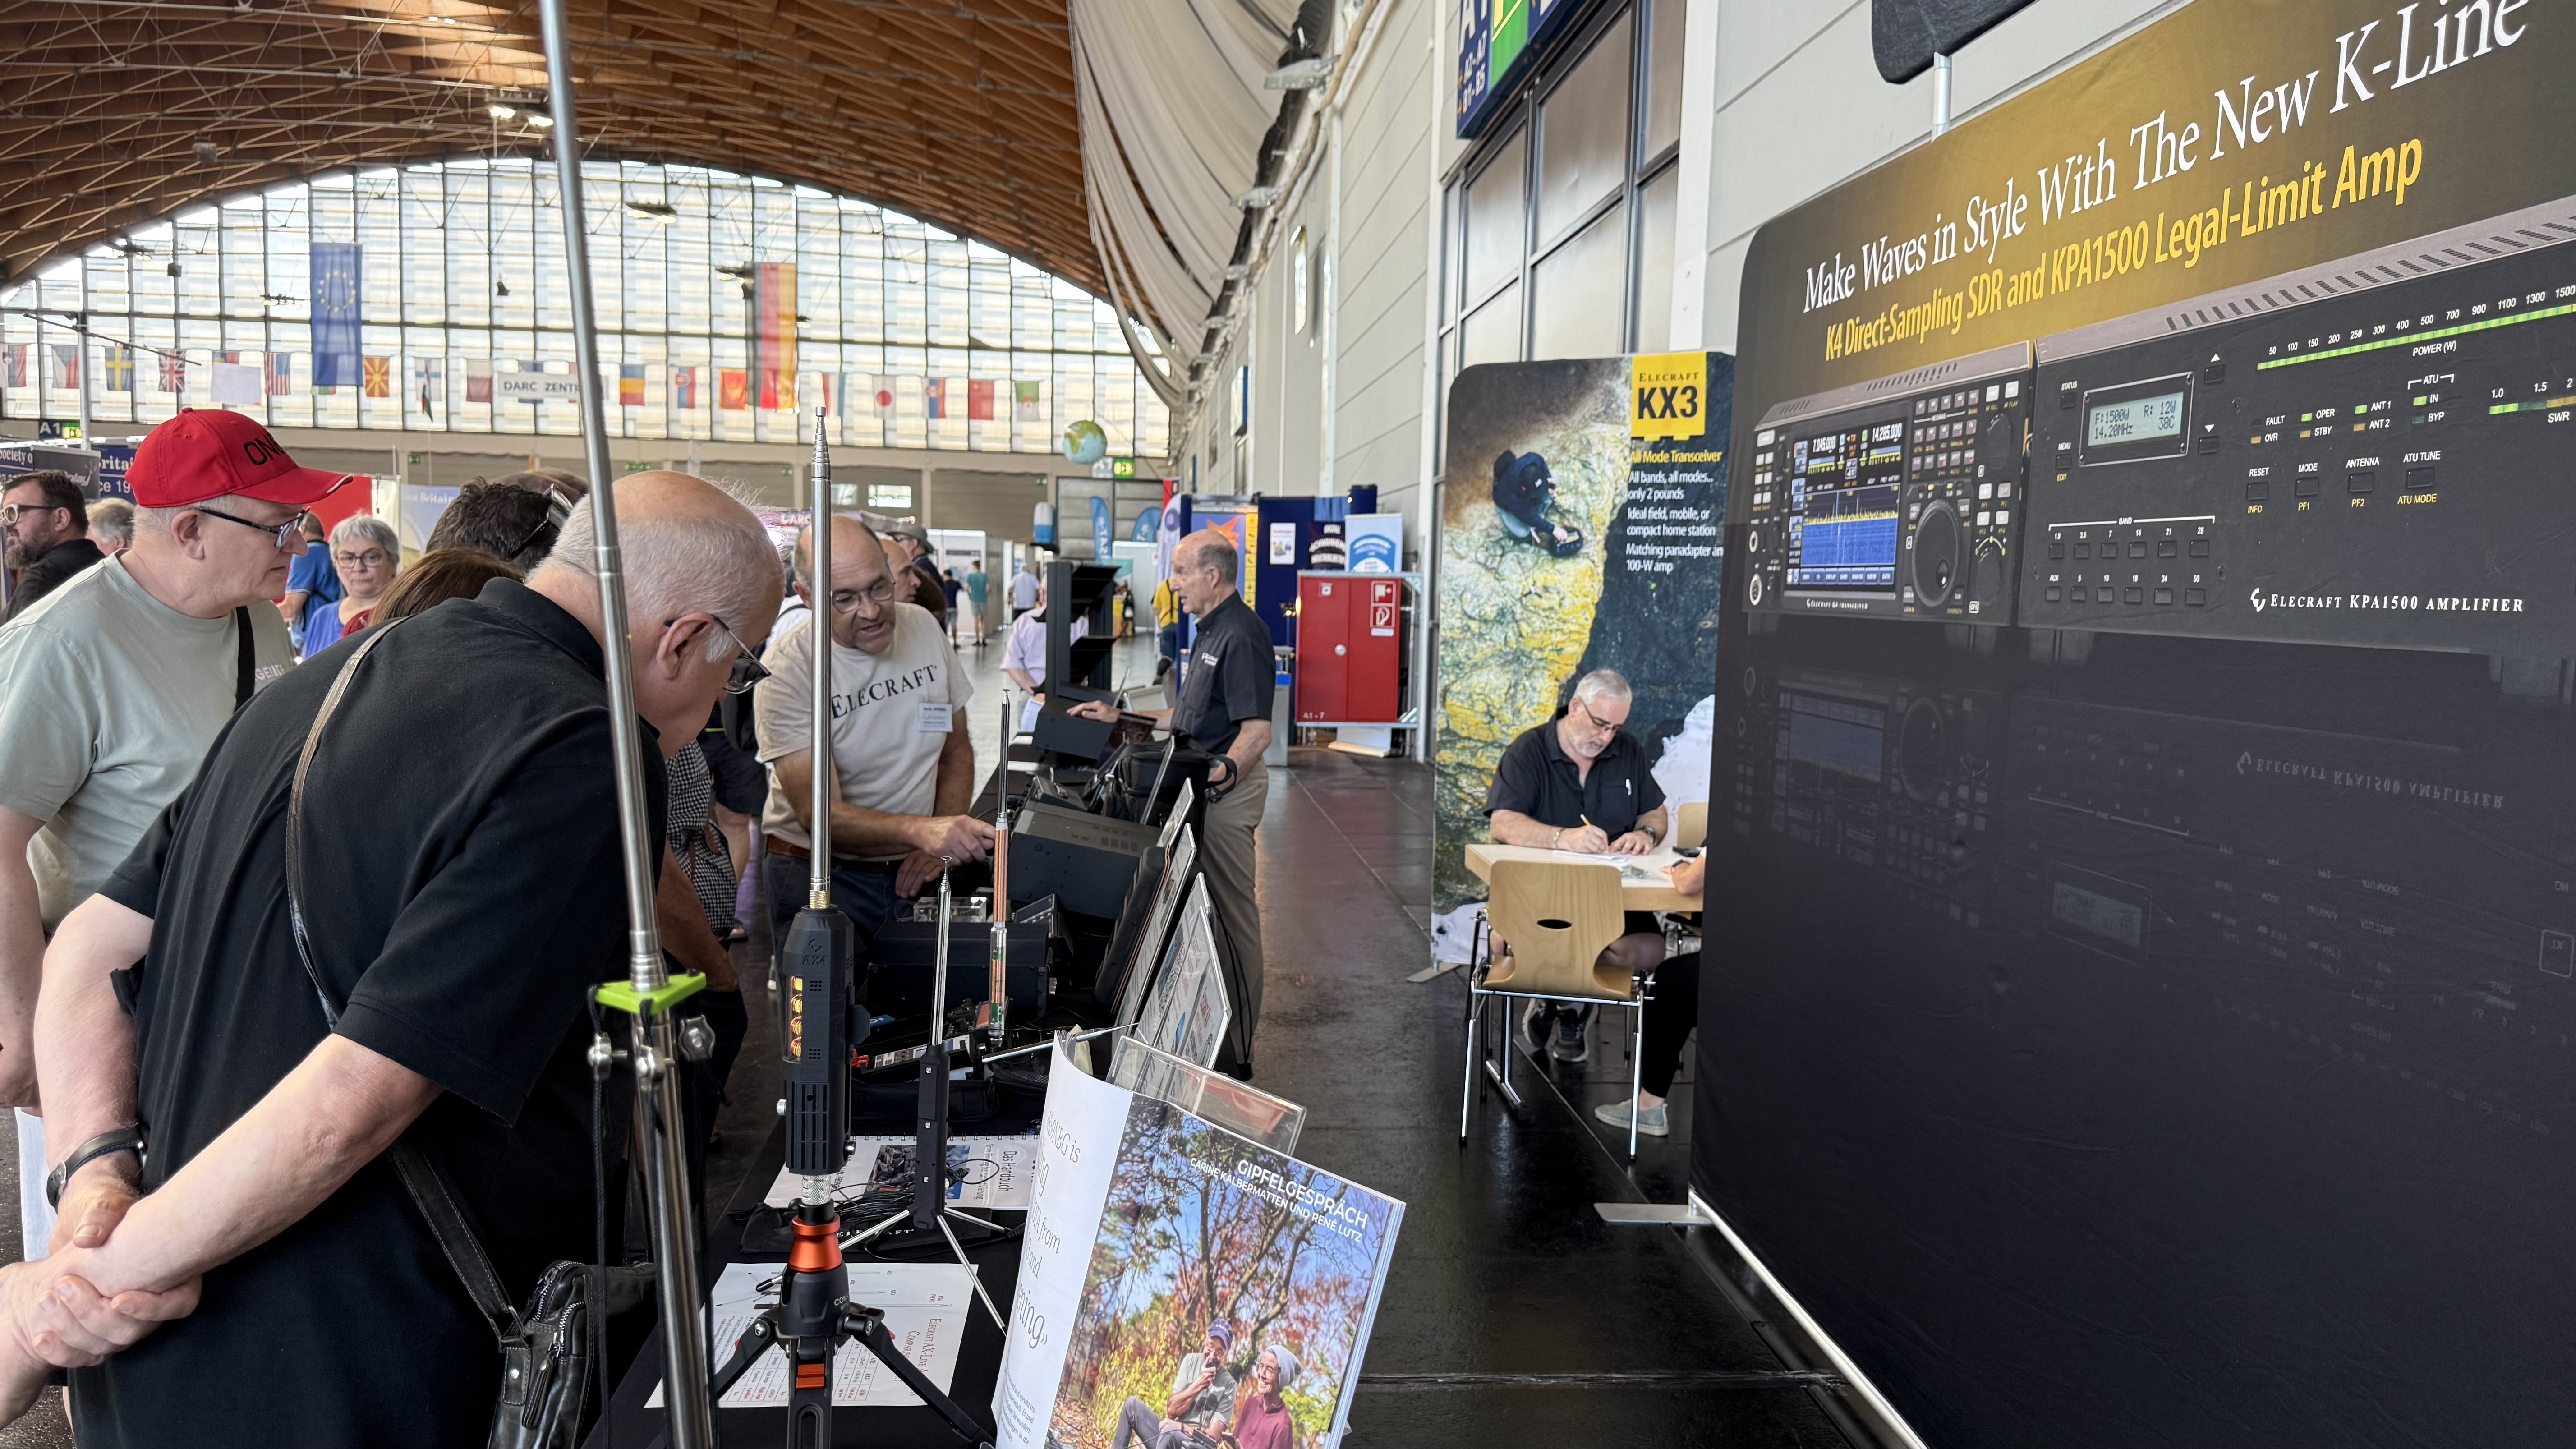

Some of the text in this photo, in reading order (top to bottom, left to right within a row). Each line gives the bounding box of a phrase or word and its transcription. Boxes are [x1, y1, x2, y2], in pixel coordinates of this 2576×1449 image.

[1803, 0, 2526, 313] Make Waves in Style With The New K-Line
[1826, 138, 2422, 361] K4 Direct-Sampling SDR and KPA1500 Legal-Limit Amp
[2269, 285, 2576, 355] 50 100 150 200 250 300 400 500 700 900 1100 1300 1500
[2413, 340, 2456, 356] POWER (W)
[504, 381, 538, 391] DARC
[2061, 381, 2078, 391] STATUS
[2423, 374, 2439, 385] ATU
[2492, 378, 2573, 399] 1.0 1.5 2
[1638, 386, 1697, 419] KX3
[2430, 394, 2438, 403] IN
[2371, 400, 2392, 412] ANT 1
[2266, 415, 2286, 426] FAULT
[2316, 408, 2335, 419] OPER
[2428, 412, 2445, 422] BYP
[2548, 411, 2570, 423] SWR
[2314, 426, 2332, 437] STBY
[2369, 419, 2390, 430] ANT 2
[2264, 433, 2278, 442] OVR
[244, 433, 286, 465] ON
[1631, 449, 1723, 463] All Mode Transceiver
[99, 455, 135, 470] ritai
[2346, 456, 2380, 469] ANTENNA
[2403, 451, 2441, 463] ATU TUNE
[2249, 467, 2269, 477] RESET
[2298, 462, 2318, 473] MODE
[1629, 470, 1640, 483] All
[1641, 470, 1667, 484] bands,
[1668, 470, 1678, 483] all
[1628, 487, 1685, 502] only 2 pounds
[2397, 493, 2438, 505] ATU MODE
[2248, 505, 2263, 514] INFO
[2298, 502, 2310, 511] PF1
[2351, 498, 2365, 507] PF2
[1628, 506, 1711, 520] Ideal field, mobile, or
[1627, 524, 1716, 538] compact home station
[1626, 543, 1664, 559] Matching
[1665, 543, 1711, 558] panadapter
[1626, 559, 1674, 575] 100-W amp
[2270, 593, 2524, 612] ELECRAFT KPA1500 AMPLIFIER
[831, 665, 936, 720] ELECRAFT
[1070, 1140, 1080, 1162] is
[998, 1151, 1017, 1191] Das Handbuch
[1190, 1158, 1362, 1242] CARINE KALBERMATTEN UND RENÉ LUTZ
[1237, 1159, 1368, 1229] GIPFELGESPRÄCH
[1038, 1217, 1060, 1254] from
[918, 1319, 942, 1367] ELECRAFT AX-LINE
